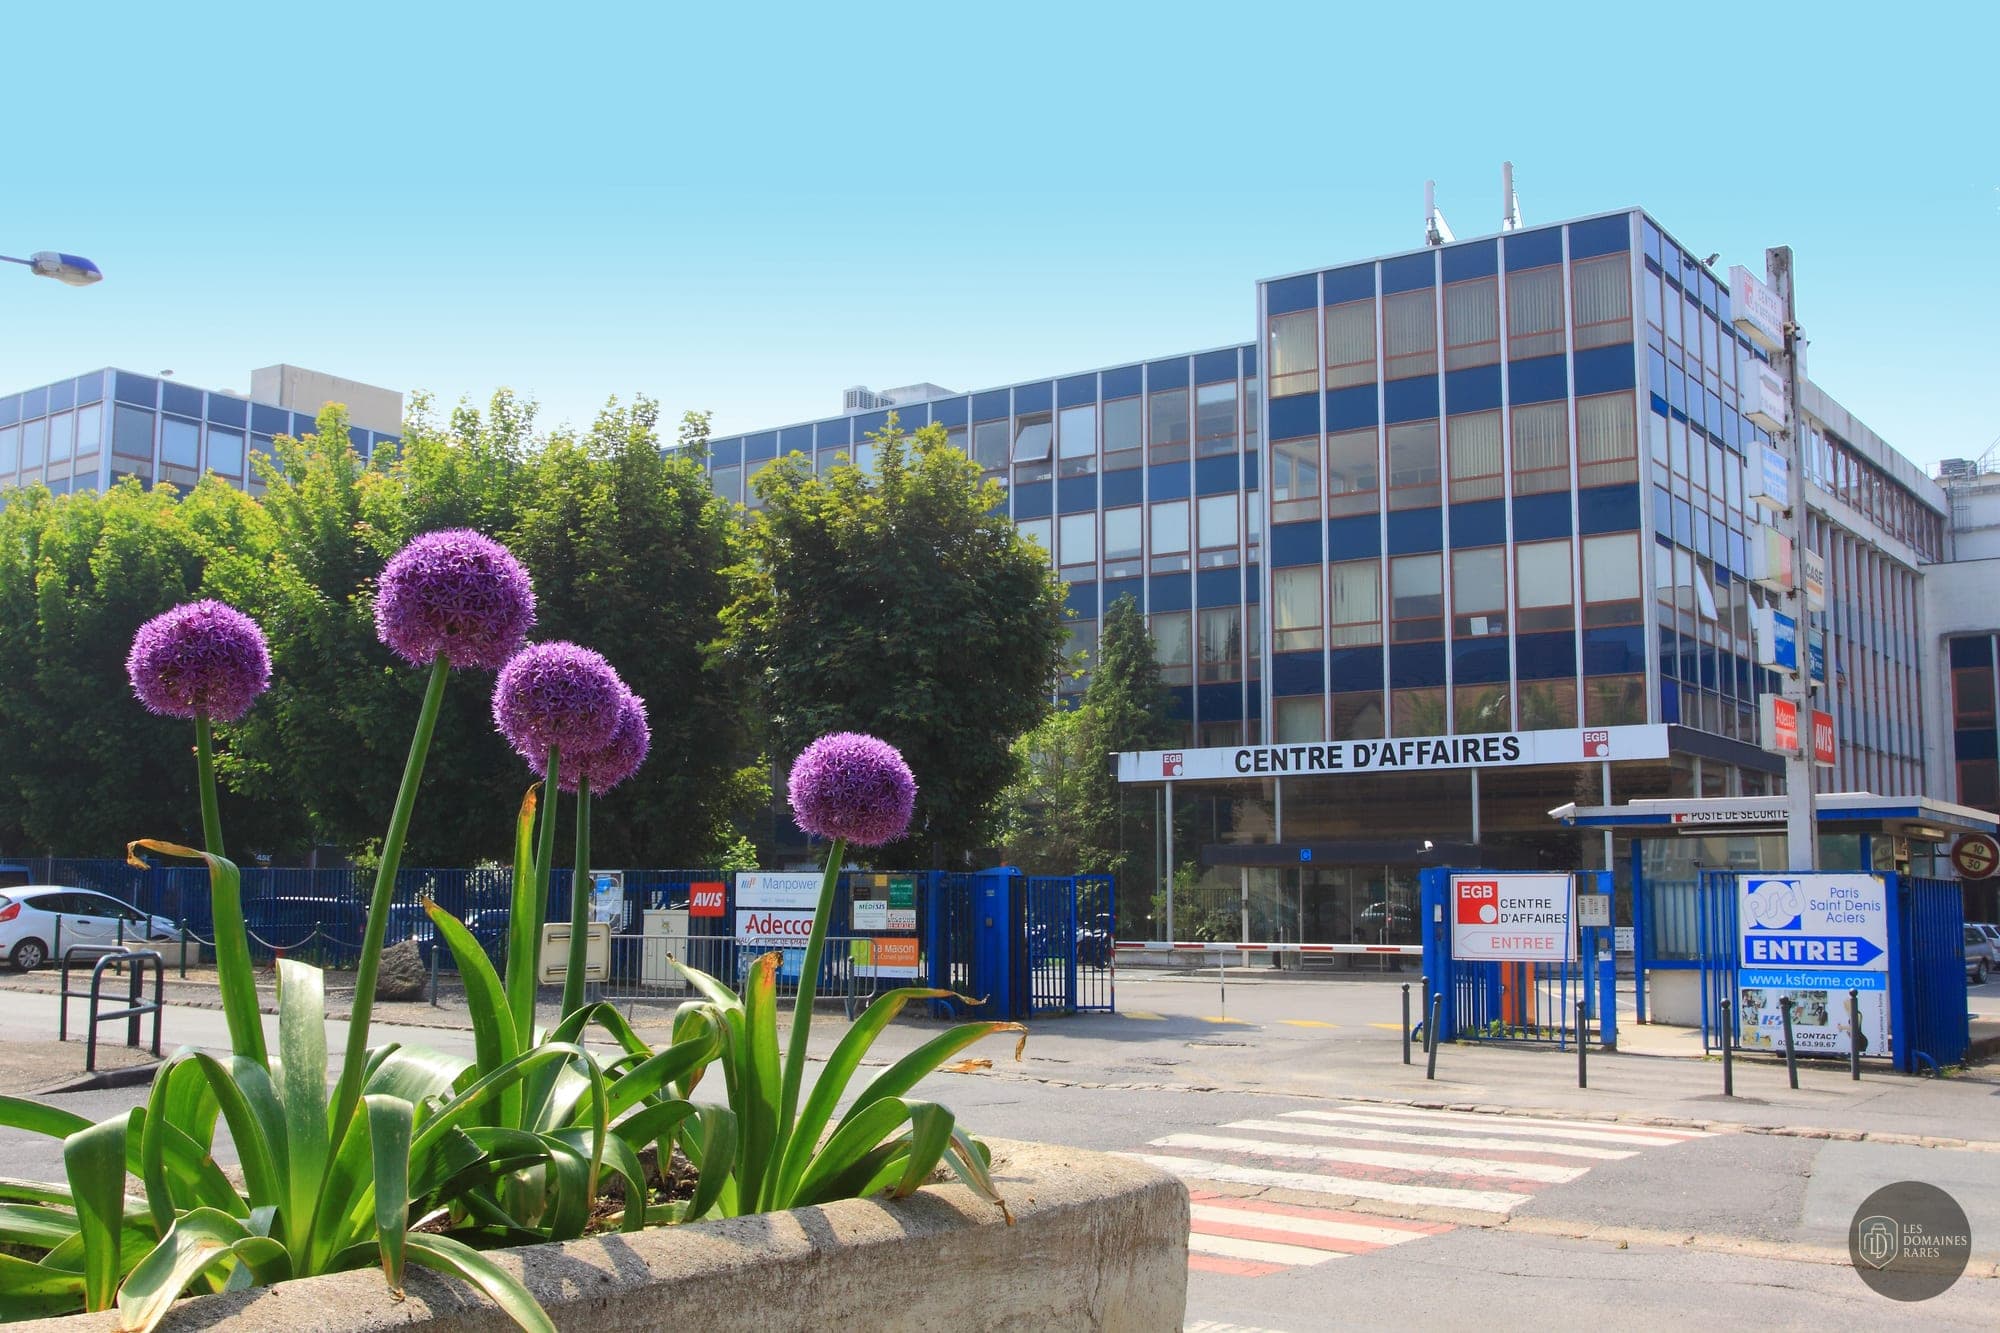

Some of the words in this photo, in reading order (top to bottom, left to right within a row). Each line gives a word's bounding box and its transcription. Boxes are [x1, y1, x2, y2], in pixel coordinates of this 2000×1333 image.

[1585, 731, 1608, 742] EGB
[1816, 723, 1832, 753] AVIS
[1163, 754, 1182, 763] EGB
[1235, 745, 1343, 773] CENTRE
[1353, 736, 1520, 768] D'AFFAIRES
[1691, 811, 1721, 820] POSTE
[1725, 811, 1738, 820] DE
[1973, 844, 1984, 855] 10
[1967, 859, 1981, 870] 30
[762, 878, 817, 892] Manpower
[1461, 885, 1493, 899] EGB
[1830, 887, 1859, 899] Paris
[693, 892, 722, 907] AVIS
[1500, 898, 1552, 909] CENTRE
[1810, 900, 1841, 911] Saint
[1845, 900, 1881, 911] Denis
[745, 912, 814, 935] Adecco
[1500, 913, 1568, 924] D'AFFAIRES
[1826, 912, 1866, 924] Aciers
[1491, 936, 1555, 950] ENTREE
[1752, 940, 1858, 962] ENTREE
[1750, 974, 1875, 988] www.ksforme.com
[1796, 1032, 1838, 1040] CONTACT
